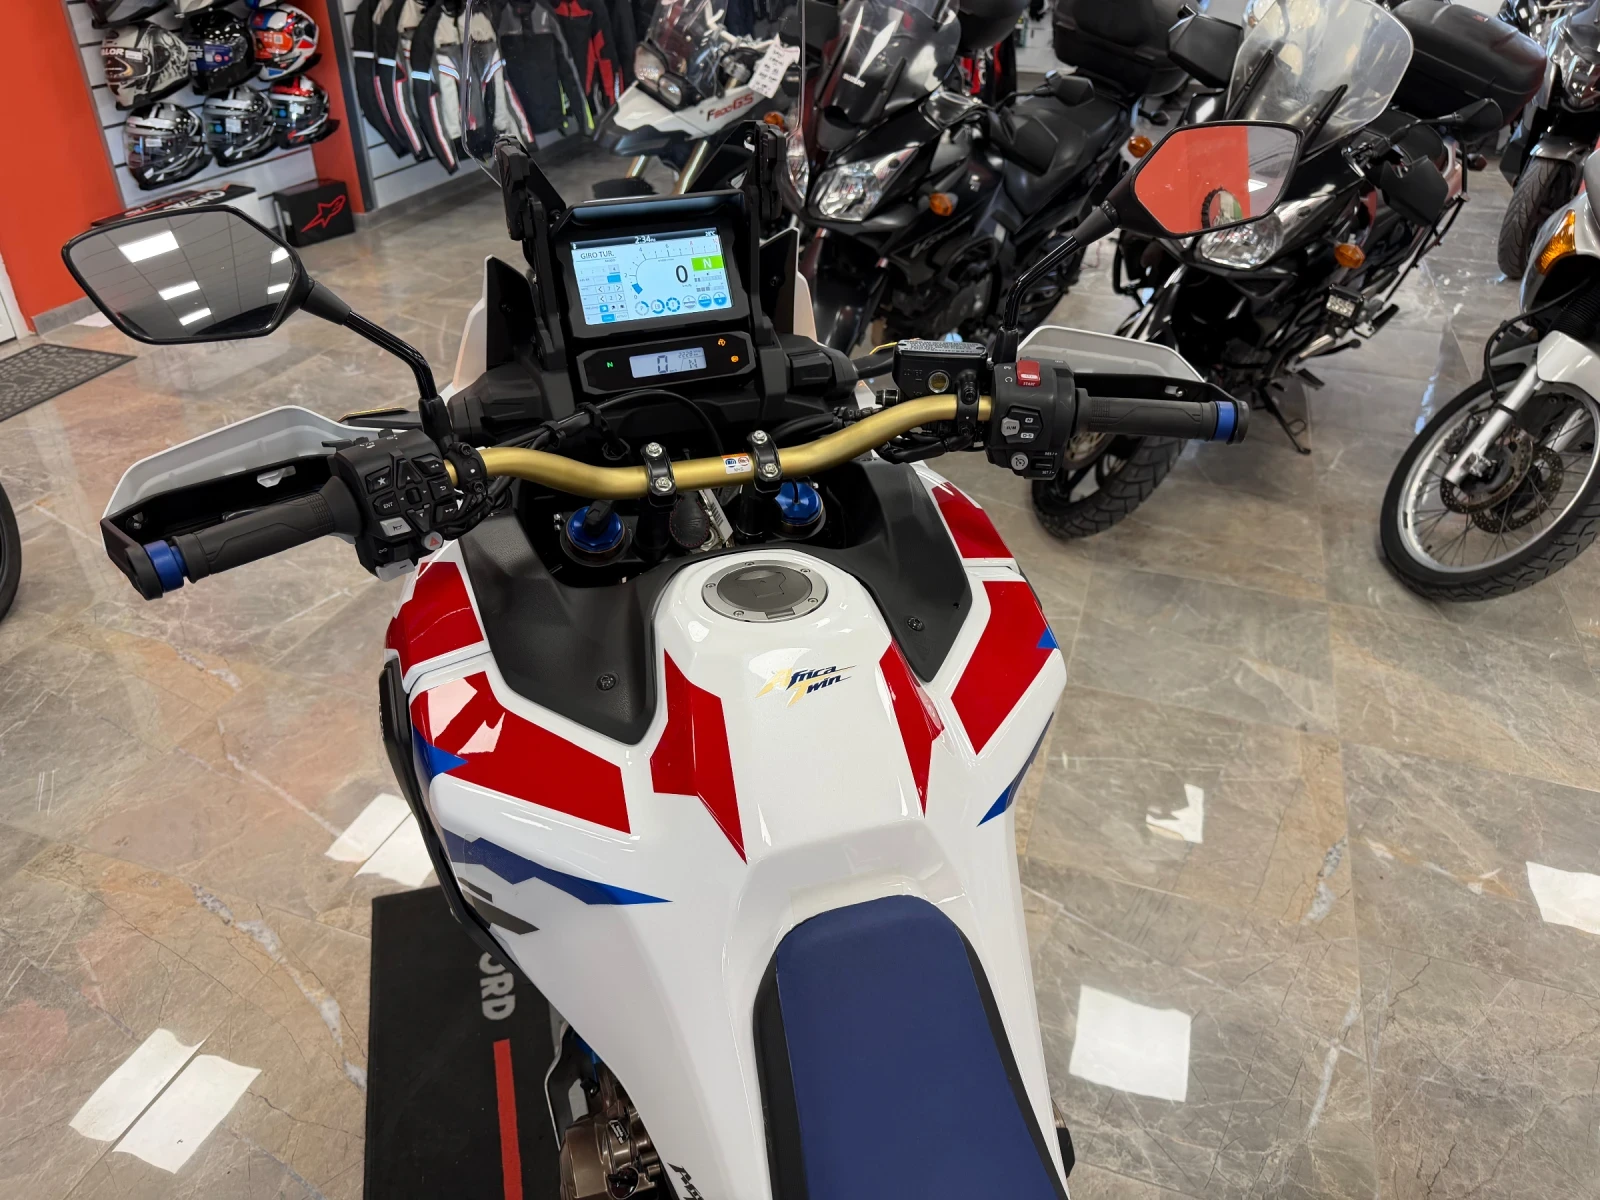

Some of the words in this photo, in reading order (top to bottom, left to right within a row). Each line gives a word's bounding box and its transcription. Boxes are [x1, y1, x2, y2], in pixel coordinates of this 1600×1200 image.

[707, 91, 755, 121] F800GS
[580, 251, 598, 260] GIRO
[702, 259, 712, 269] N
[675, 264, 688, 284] 0
[657, 355, 669, 374] 0
